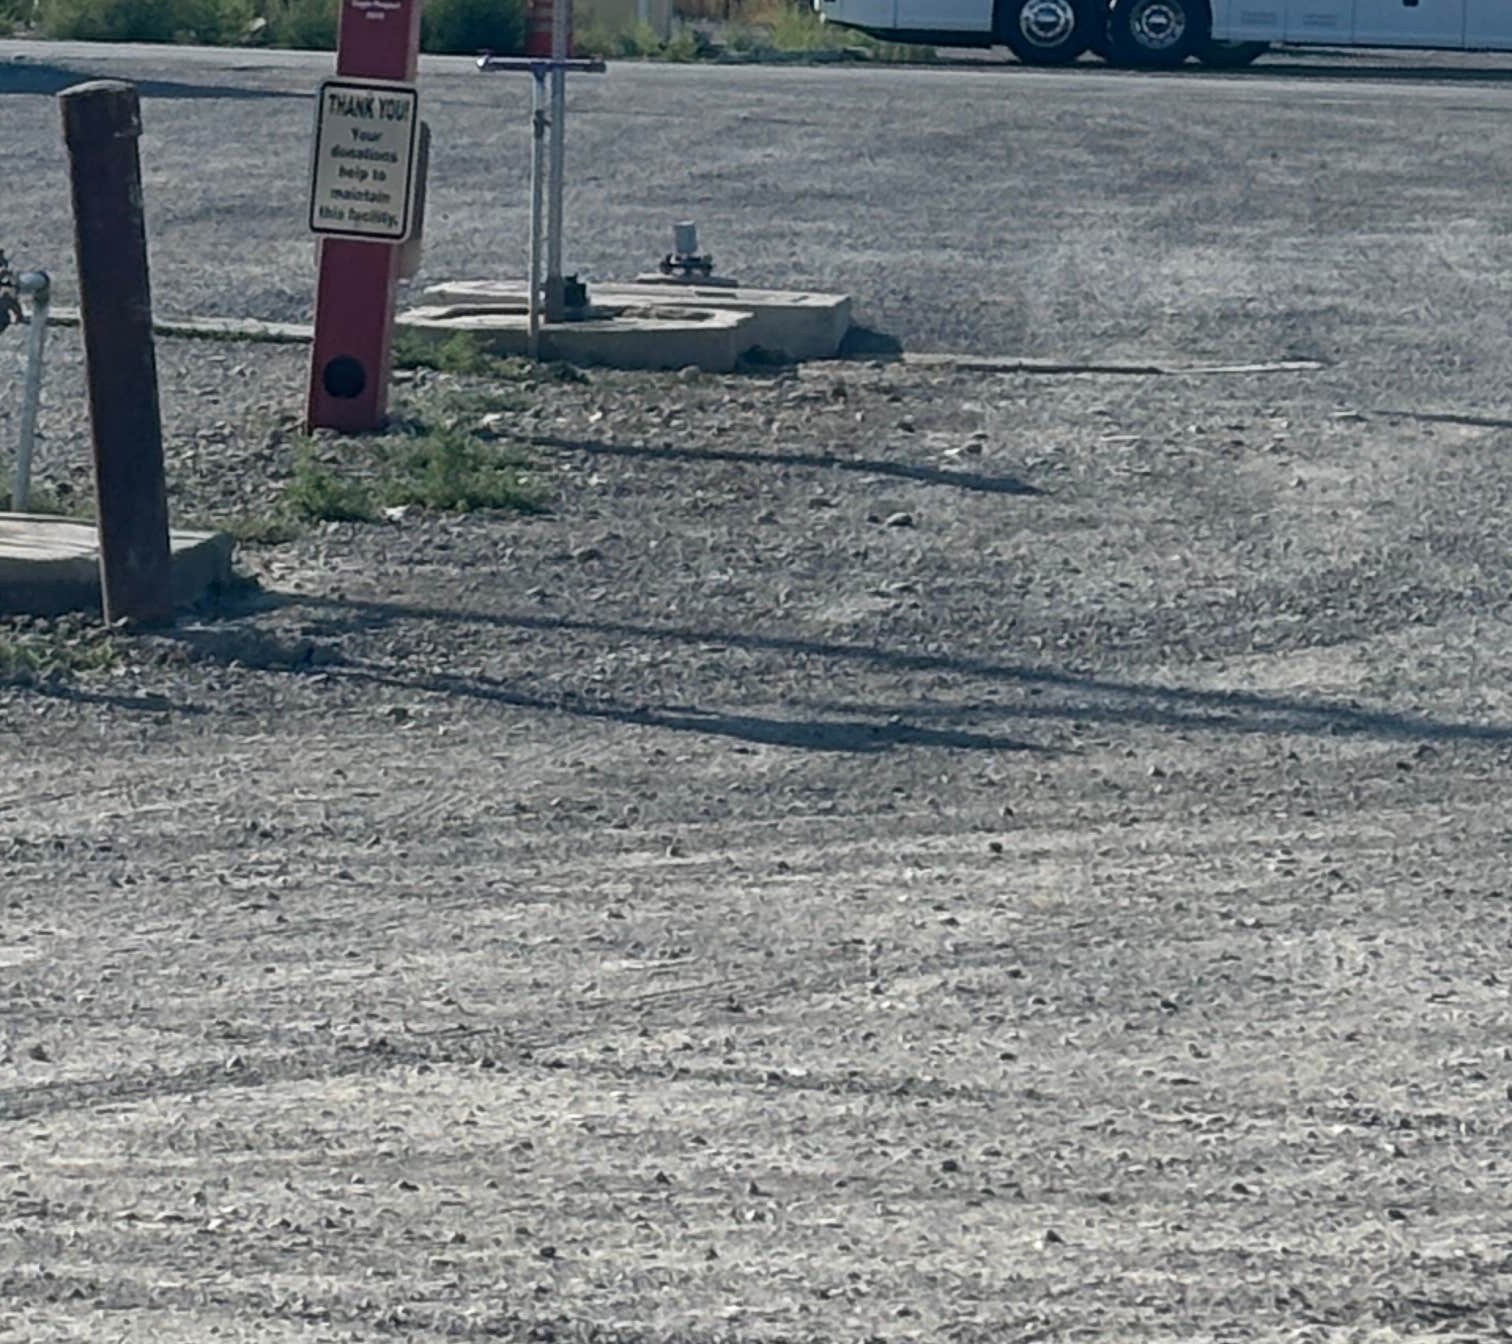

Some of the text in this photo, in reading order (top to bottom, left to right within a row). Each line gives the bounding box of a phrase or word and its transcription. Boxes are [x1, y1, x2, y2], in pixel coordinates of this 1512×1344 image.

[328, 93, 375, 120] THANK
[351, 127, 384, 142] Your
[330, 144, 398, 163] donations
[338, 165, 387, 182] help to
[329, 188, 391, 203] maintain
[319, 205, 345, 221] this
